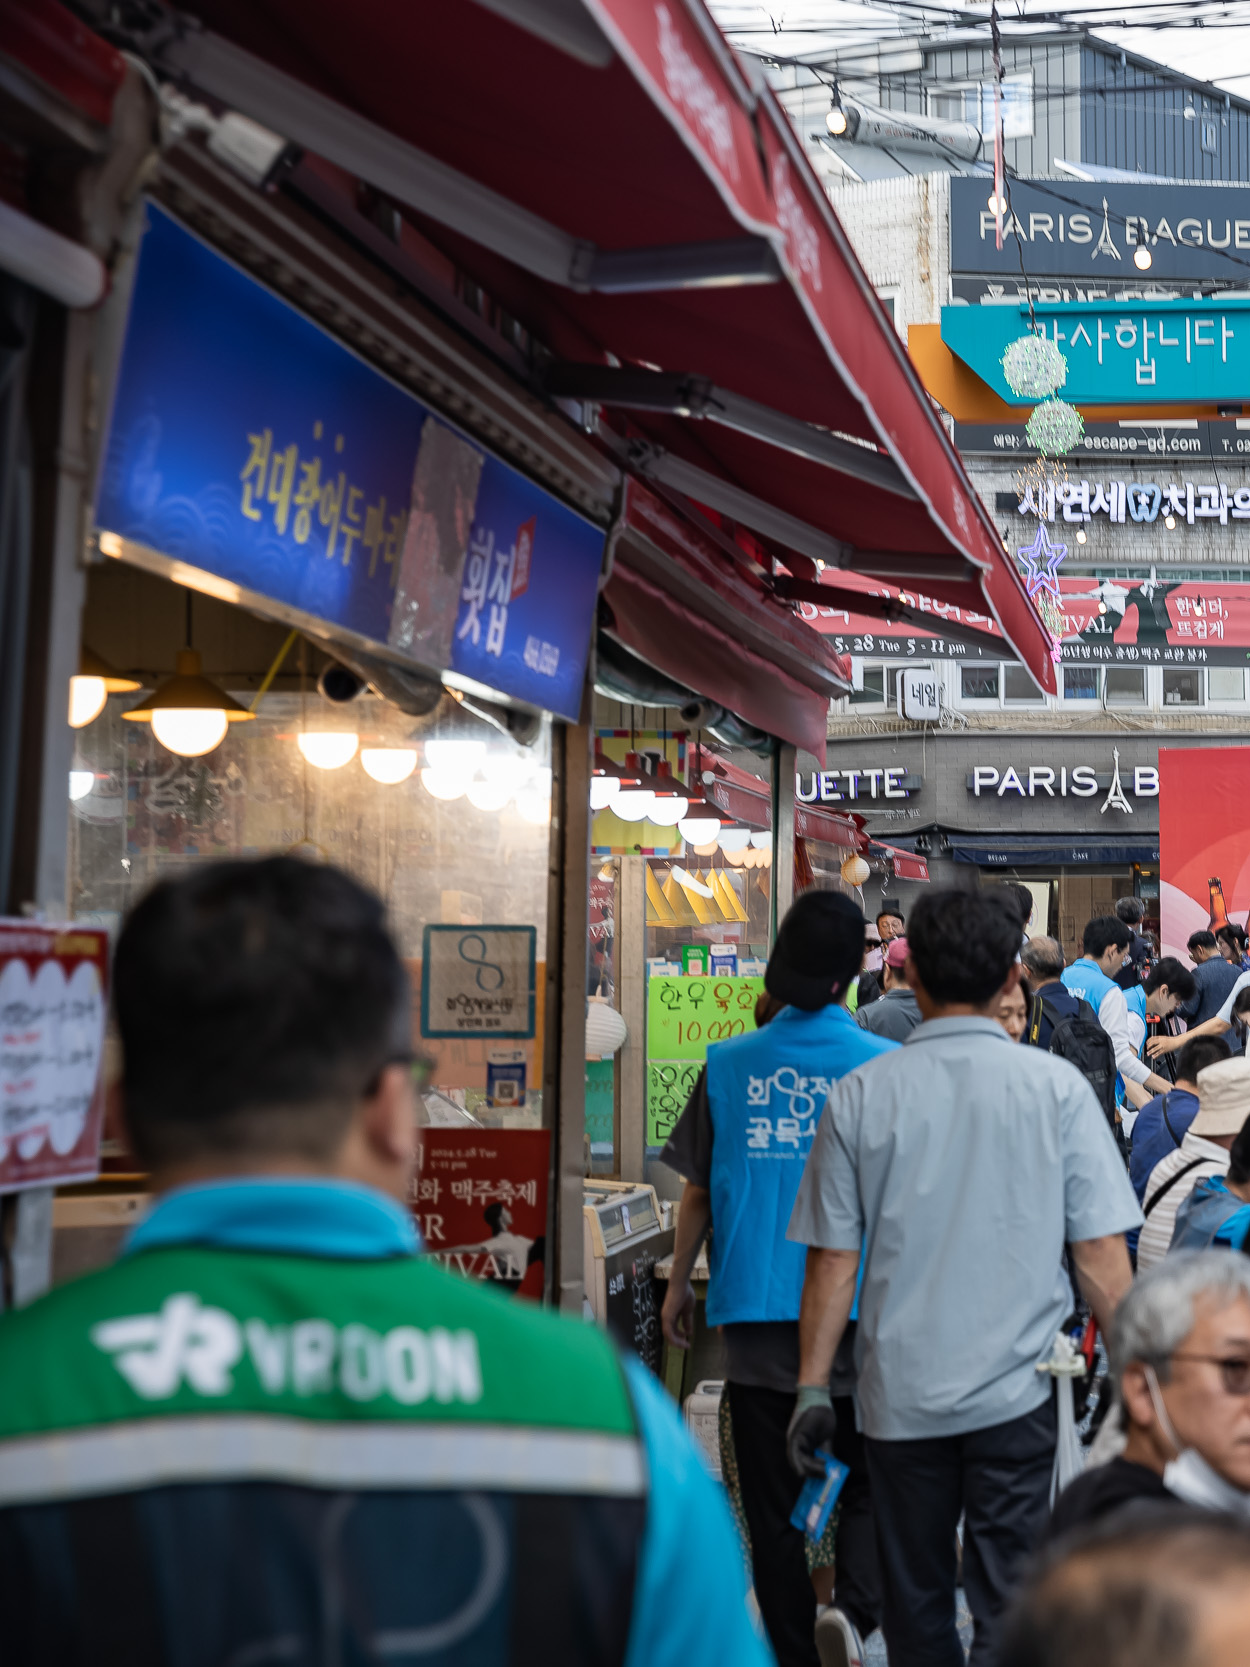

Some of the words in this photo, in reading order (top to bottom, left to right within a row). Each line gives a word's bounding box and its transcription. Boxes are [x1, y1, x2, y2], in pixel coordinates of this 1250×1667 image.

[979, 210, 1094, 244] PARIS
[1176, 619, 1225, 641] 뜨겁게
[854, 634, 874, 652] 28
[878, 638, 901, 653] Tue
[906, 638, 917, 655] 5
[930, 639, 946, 653] 11
[949, 642, 967, 656] pm
[911, 682, 937, 709] 네일
[795, 766, 908, 802] UETTE
[974, 766, 1098, 797] PARIS
[660, 981, 706, 1011] 한우
[450, 1178, 537, 1207] 맥주축제
